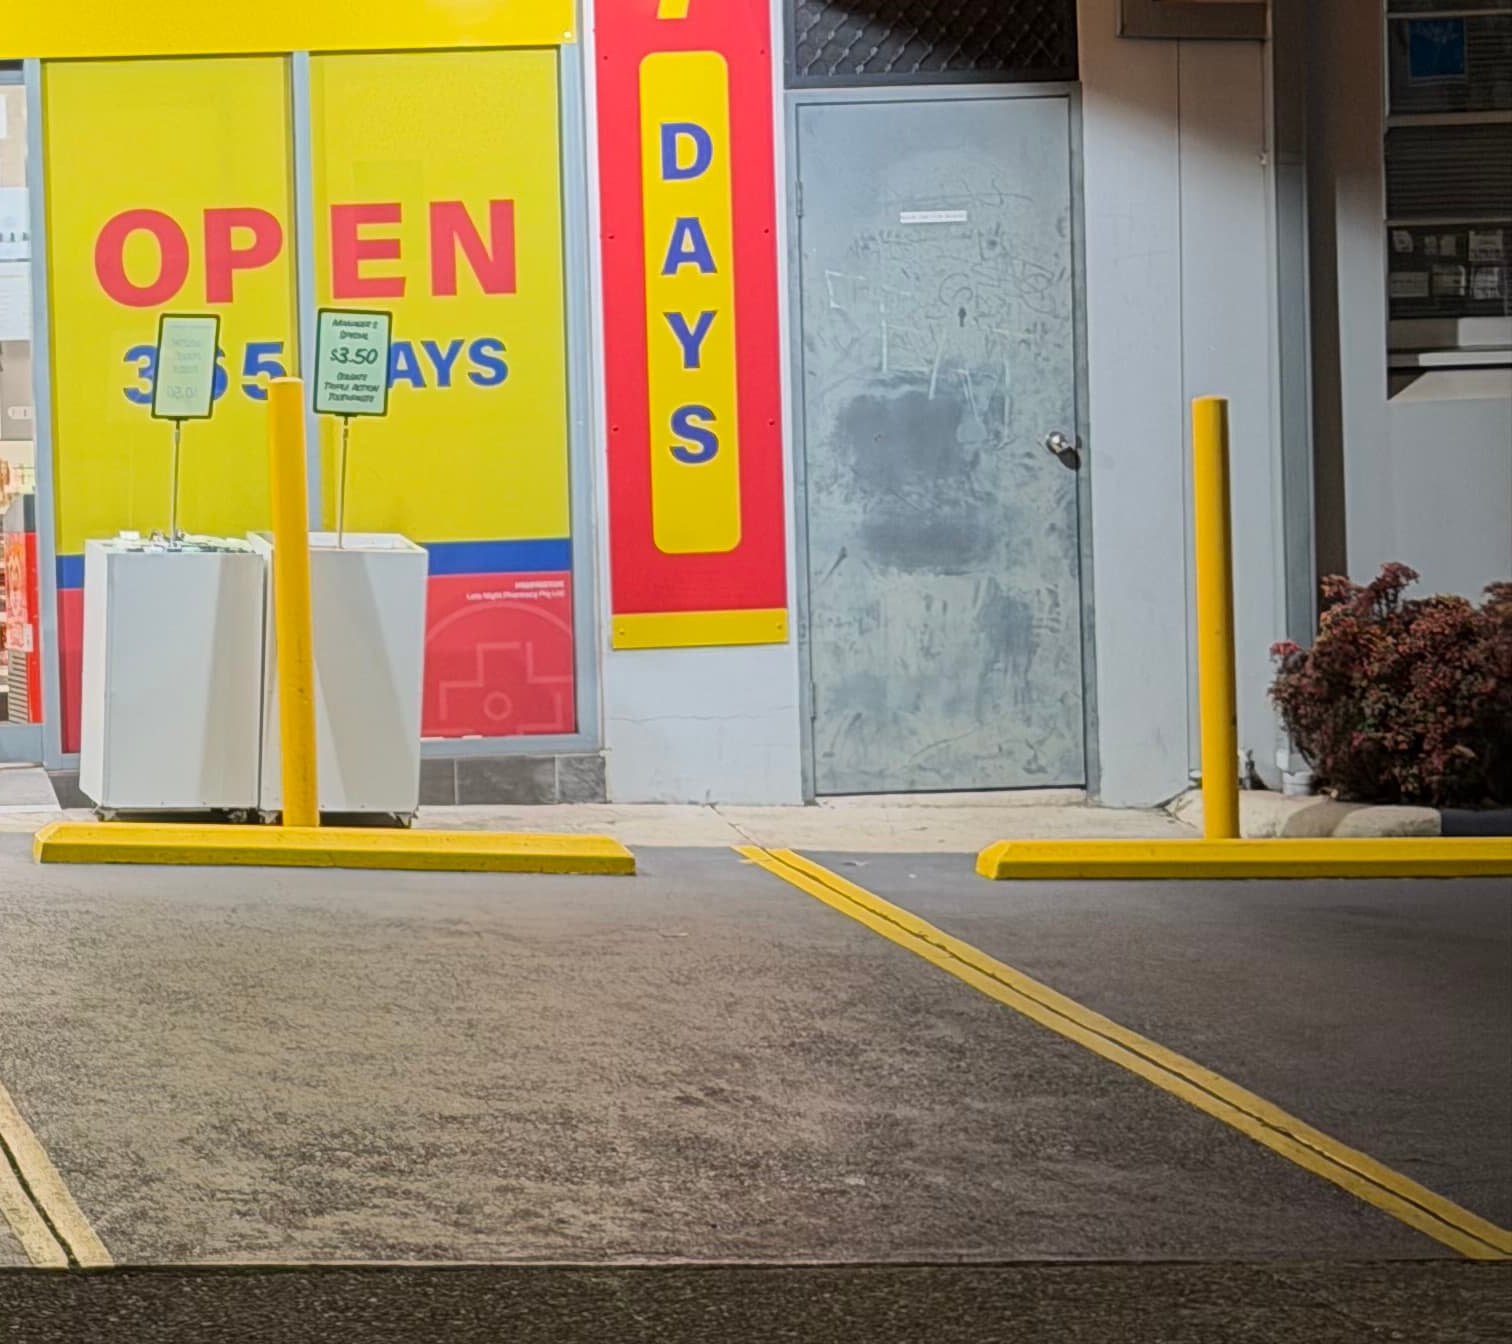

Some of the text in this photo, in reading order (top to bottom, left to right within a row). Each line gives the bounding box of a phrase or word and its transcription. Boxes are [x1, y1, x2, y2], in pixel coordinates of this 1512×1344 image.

[94, 199, 518, 308] OPEN
[660, 122, 719, 465] DAYS
[330, 347, 379, 365] $3.50
[388, 338, 509, 389] AYS
